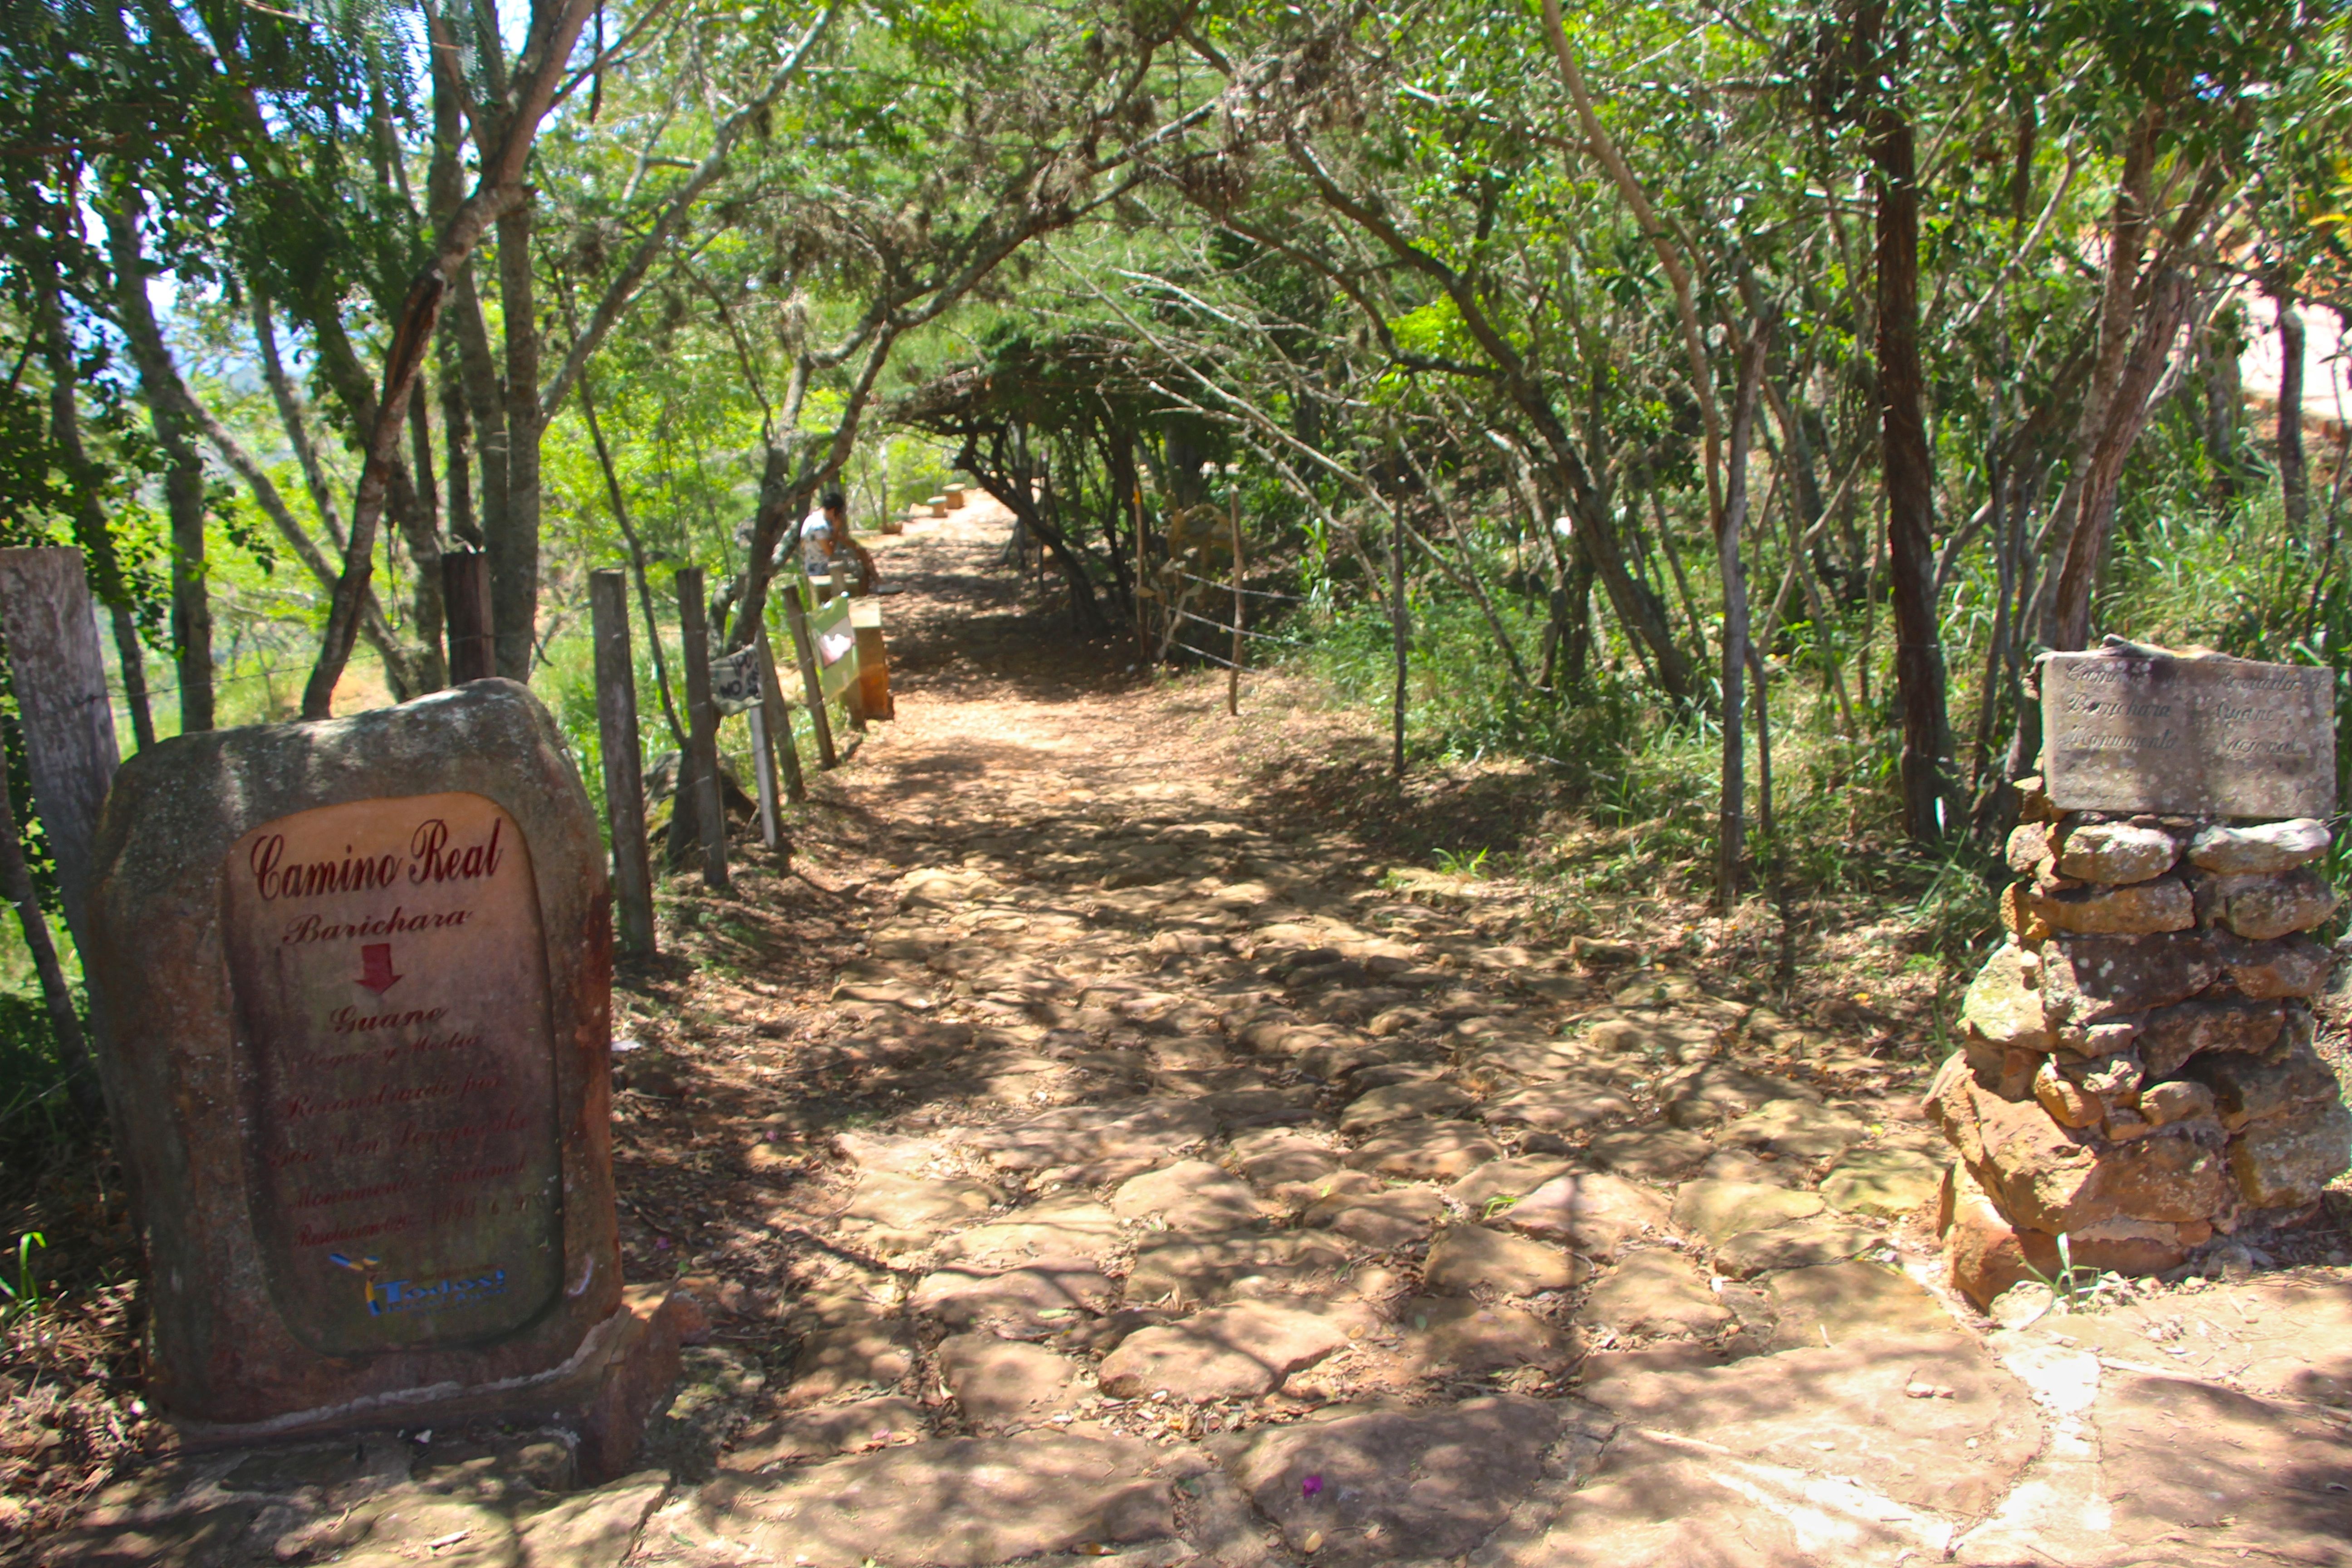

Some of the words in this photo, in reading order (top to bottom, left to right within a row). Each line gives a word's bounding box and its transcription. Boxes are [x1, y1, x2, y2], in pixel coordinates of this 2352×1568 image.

[250, 834, 403, 901] Camino
[408, 818, 502, 885] Real
[282, 906, 473, 946] Barichara
[329, 1004, 449, 1034] Guane
[373, 1269, 506, 1304] Todos!
